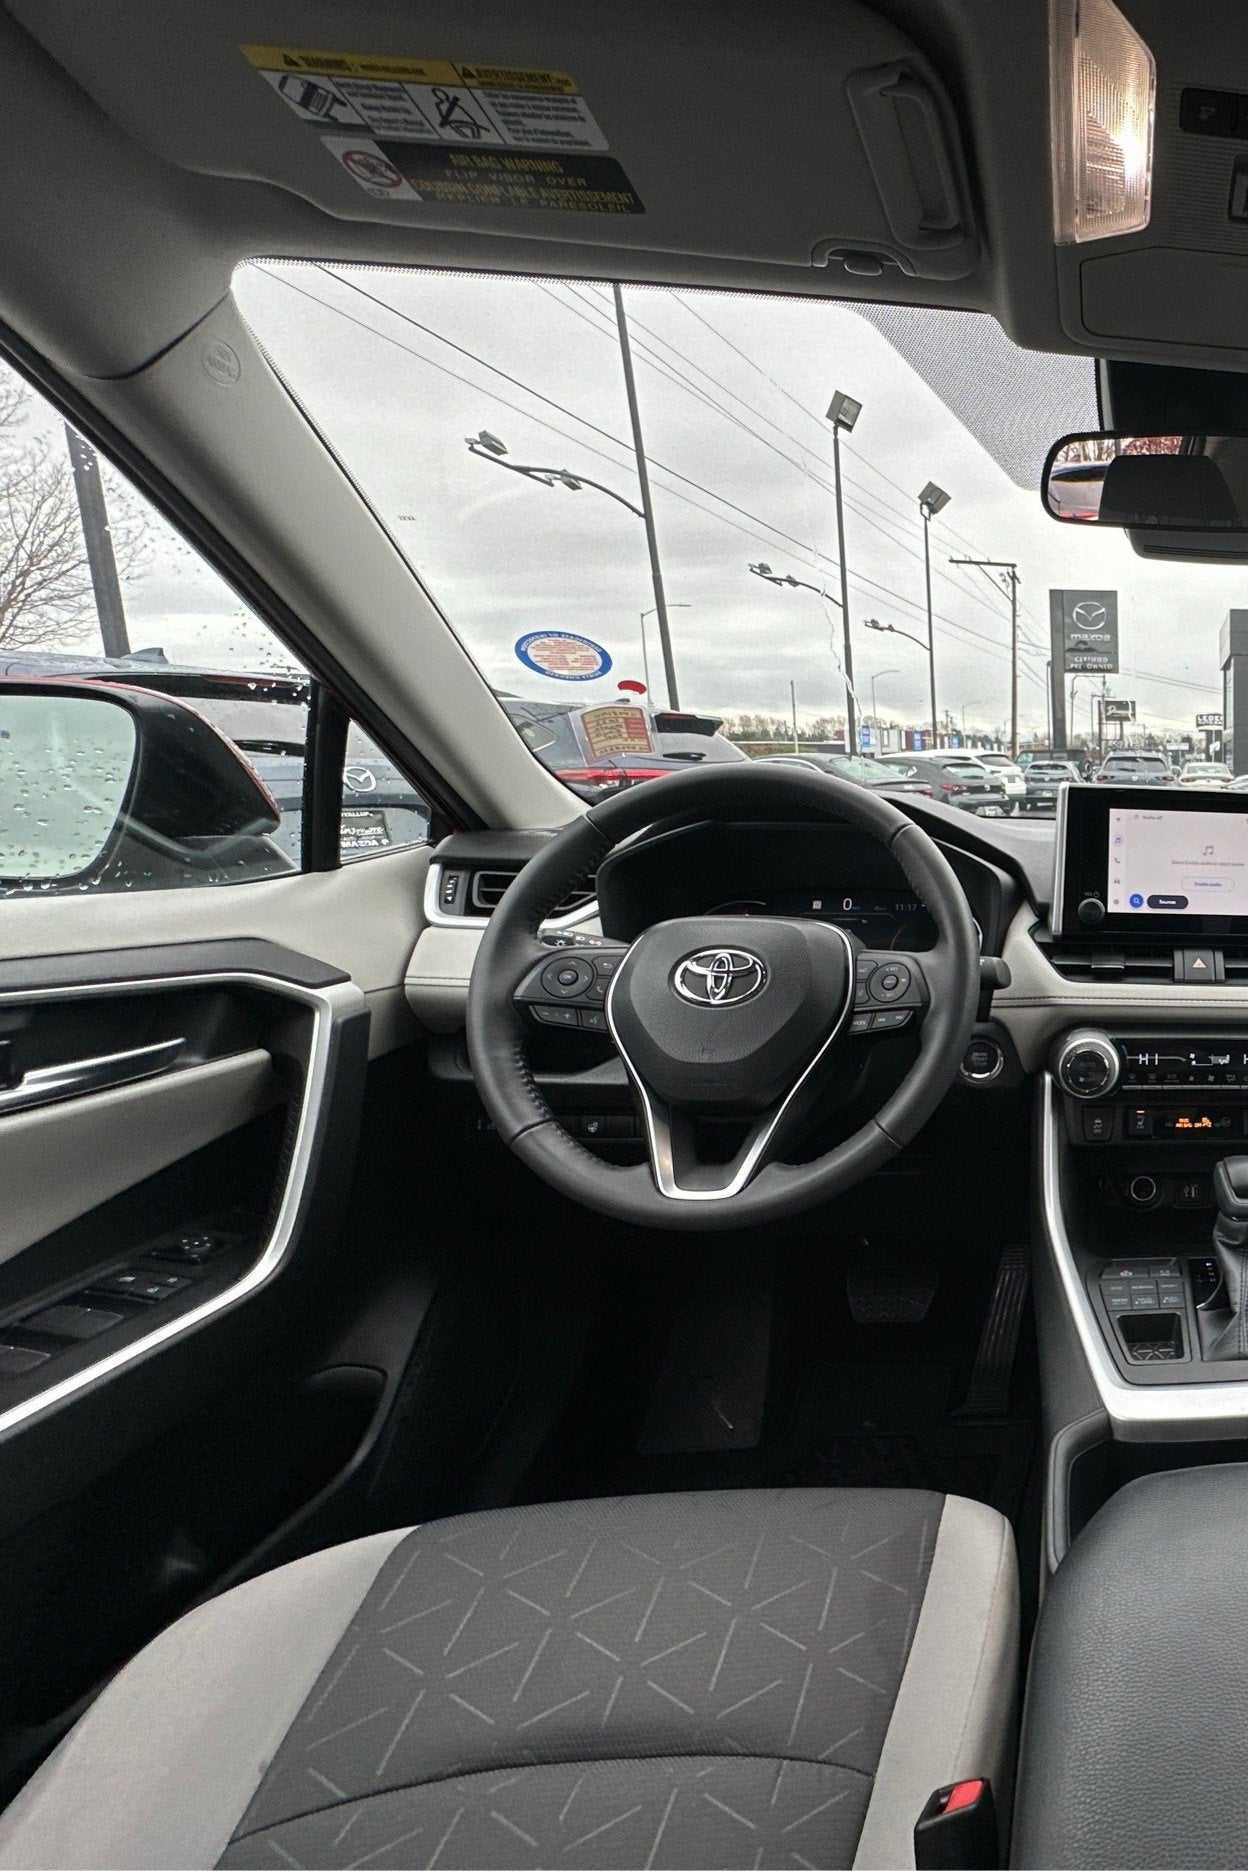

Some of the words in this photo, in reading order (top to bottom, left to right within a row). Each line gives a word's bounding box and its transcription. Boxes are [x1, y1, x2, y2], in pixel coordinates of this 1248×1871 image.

[449, 153, 473, 166] AIR
[471, 154, 500, 169] BAG
[500, 157, 564, 174] WARNING
[444, 169, 478, 179] FLIP
[488, 172, 536, 184] VISOR
[545, 176, 587, 186] OVER
[539, 187, 635, 205] AVERTISSEMENT
[842, 898, 853, 911] 0
[894, 903, 918, 911] 11:17
[1138, 1052, 1159, 1066] HI
